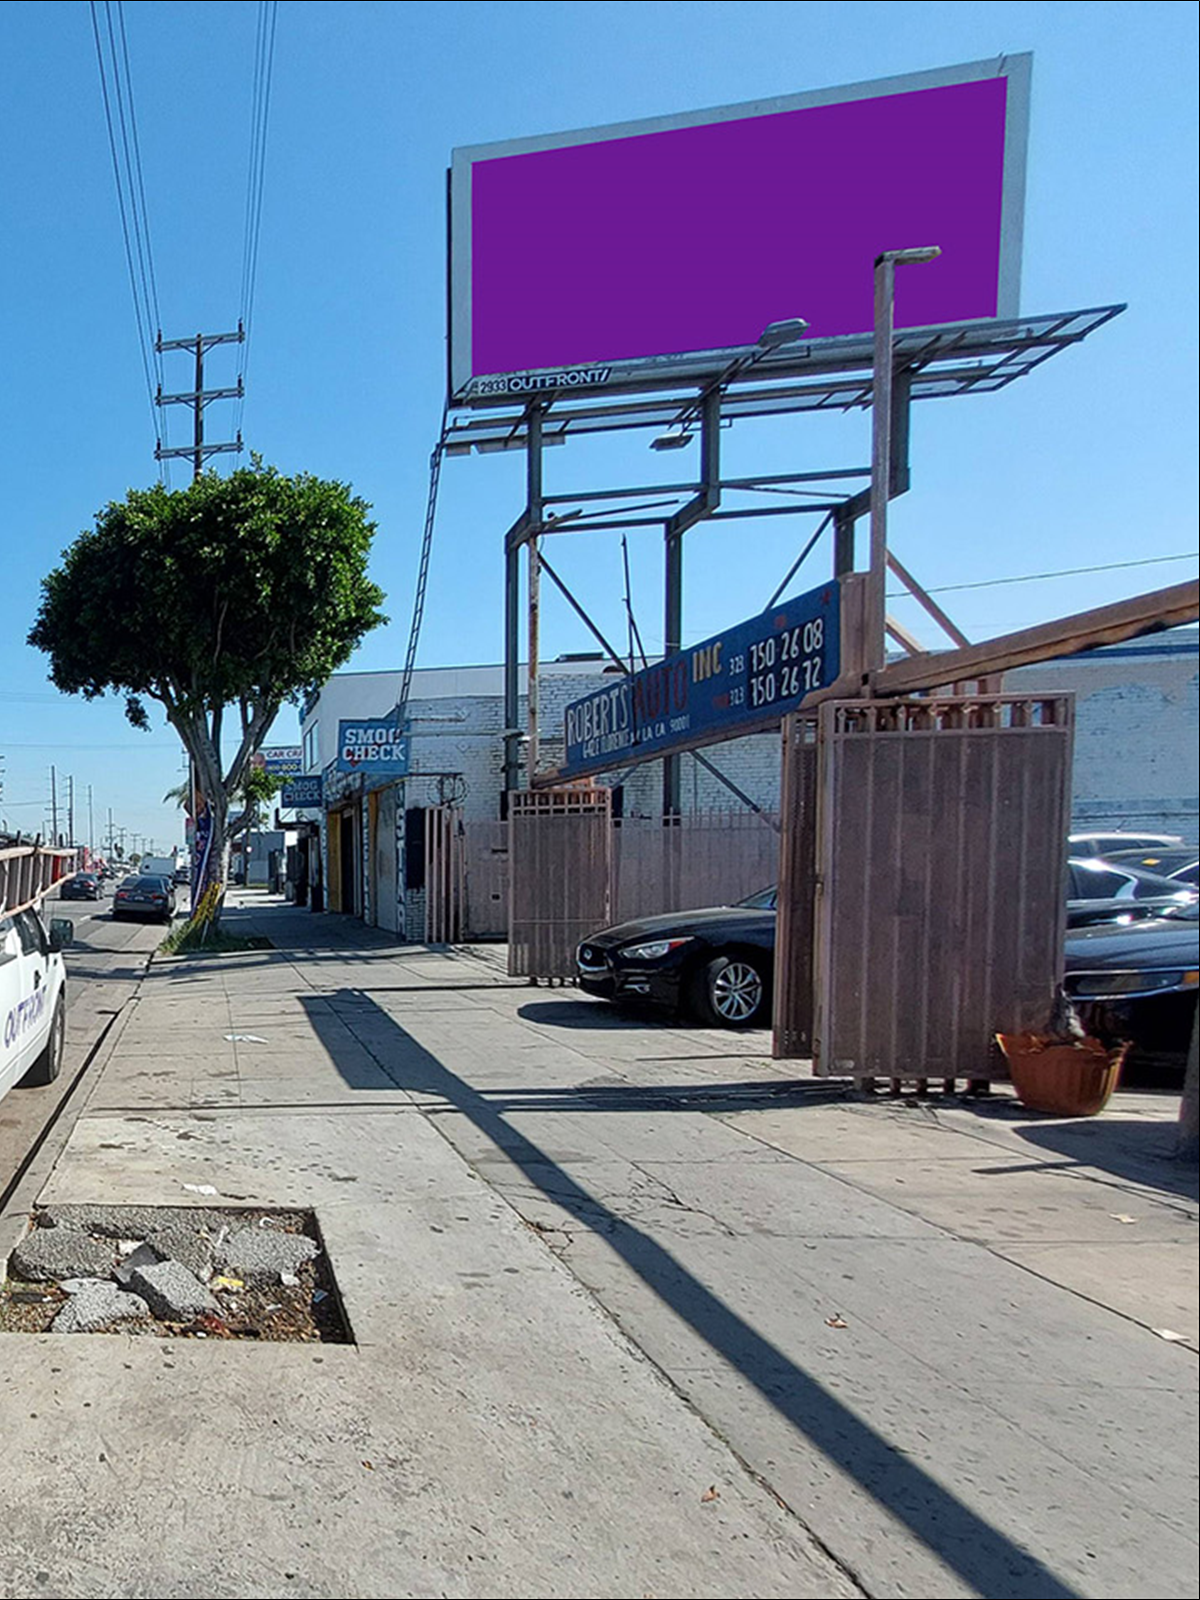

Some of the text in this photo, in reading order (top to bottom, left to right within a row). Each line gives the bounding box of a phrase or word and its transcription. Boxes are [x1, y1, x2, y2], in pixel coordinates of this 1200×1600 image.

[566, 641, 722, 747] ROBERTS AUTO INC
[342, 744, 405, 761] CHECK
